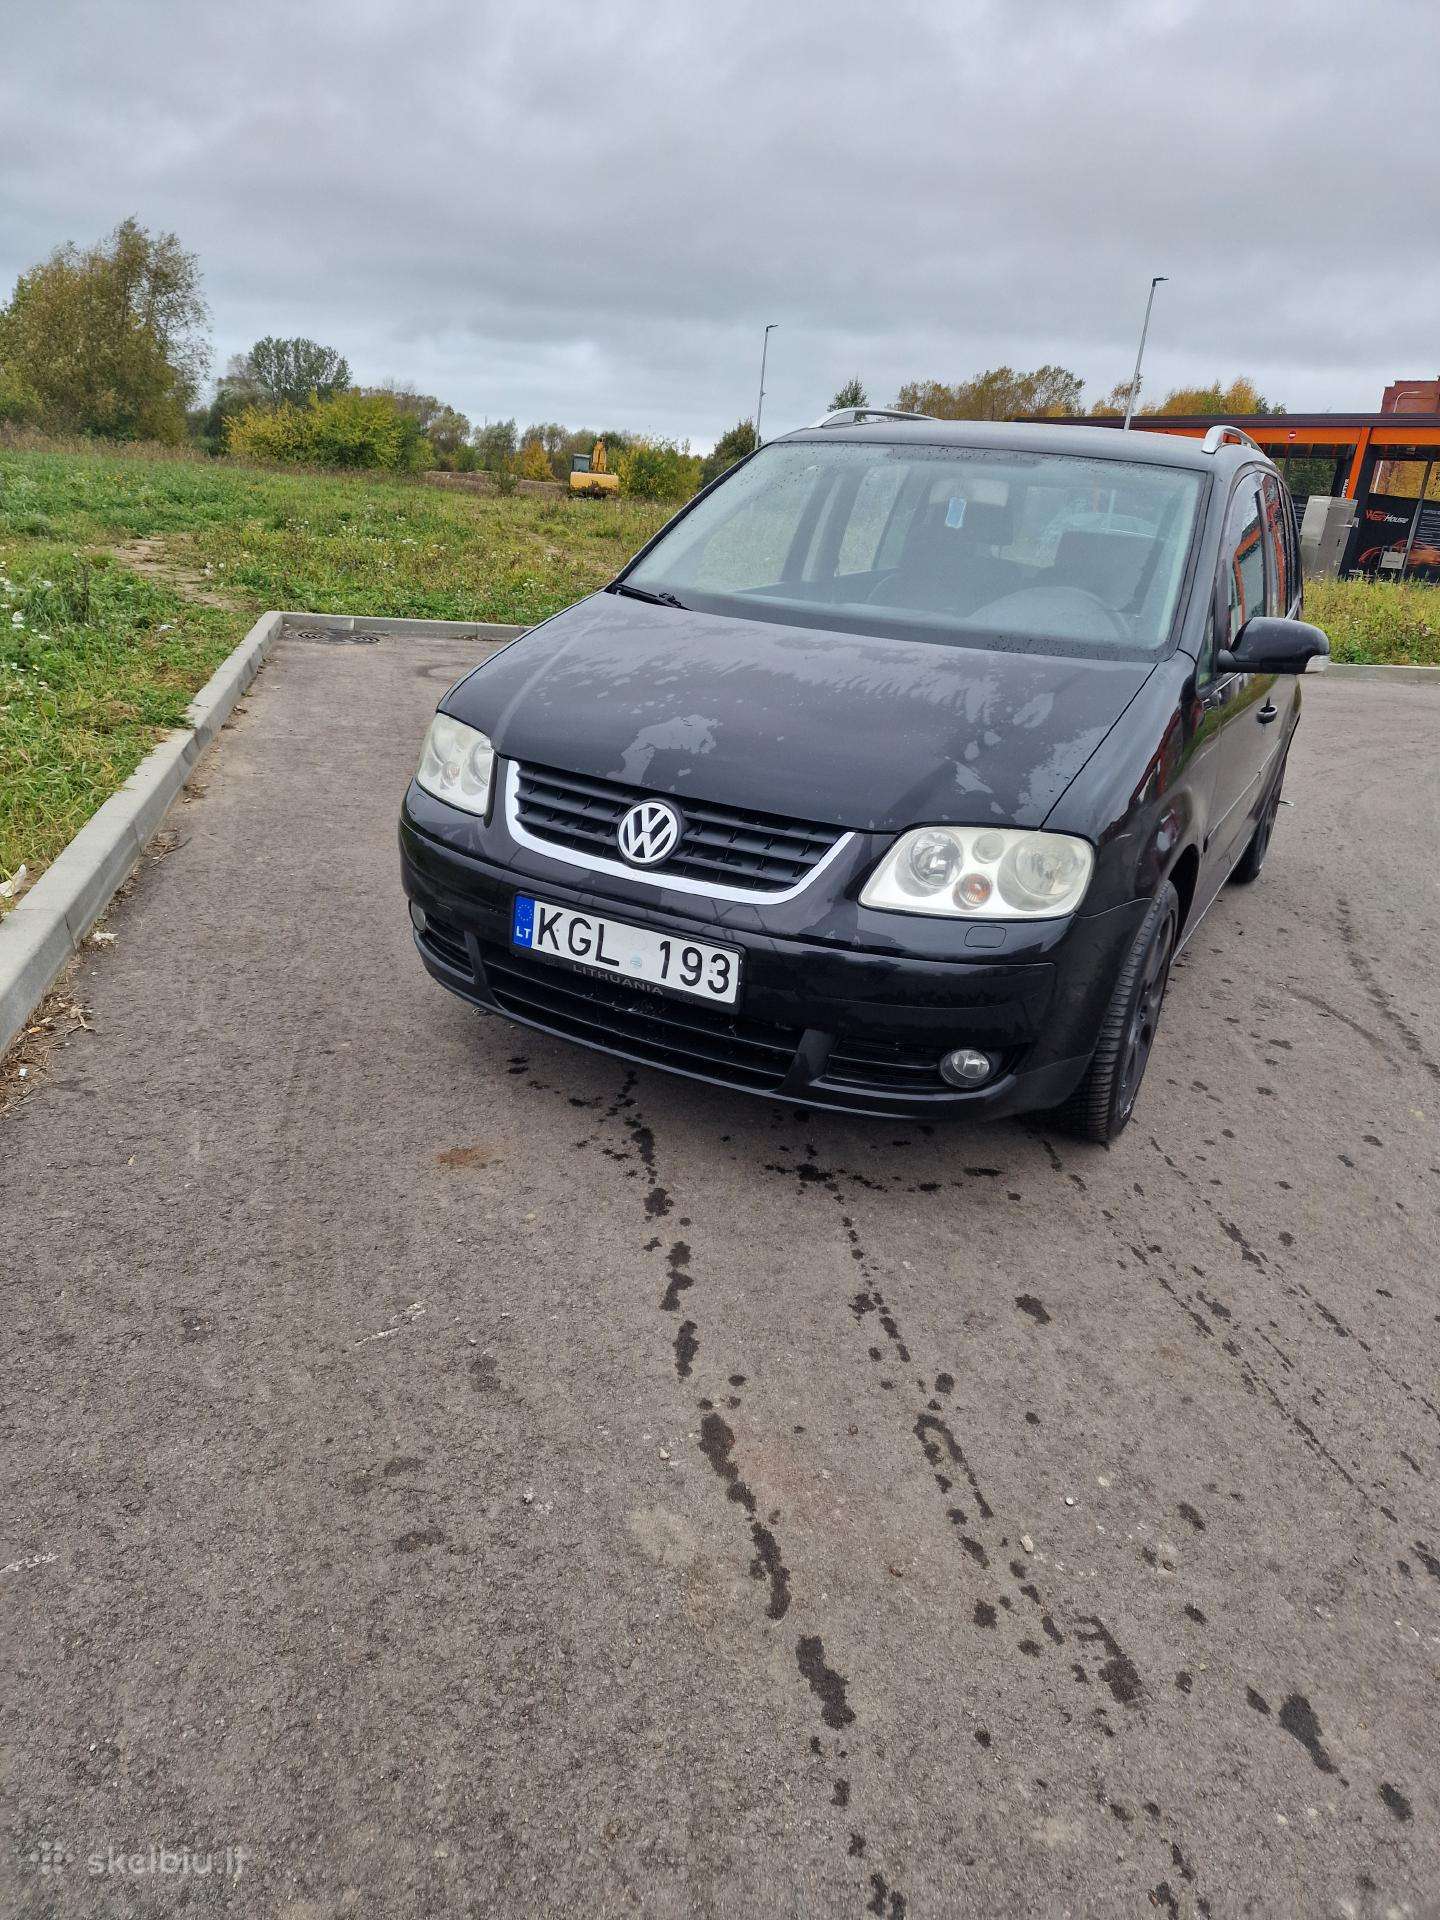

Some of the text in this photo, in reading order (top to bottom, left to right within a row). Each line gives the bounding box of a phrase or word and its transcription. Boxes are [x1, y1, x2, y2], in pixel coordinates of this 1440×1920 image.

[515, 925, 532, 939] LT
[537, 907, 731, 994] KGL 193
[572, 963, 664, 996] LITHUANIA
